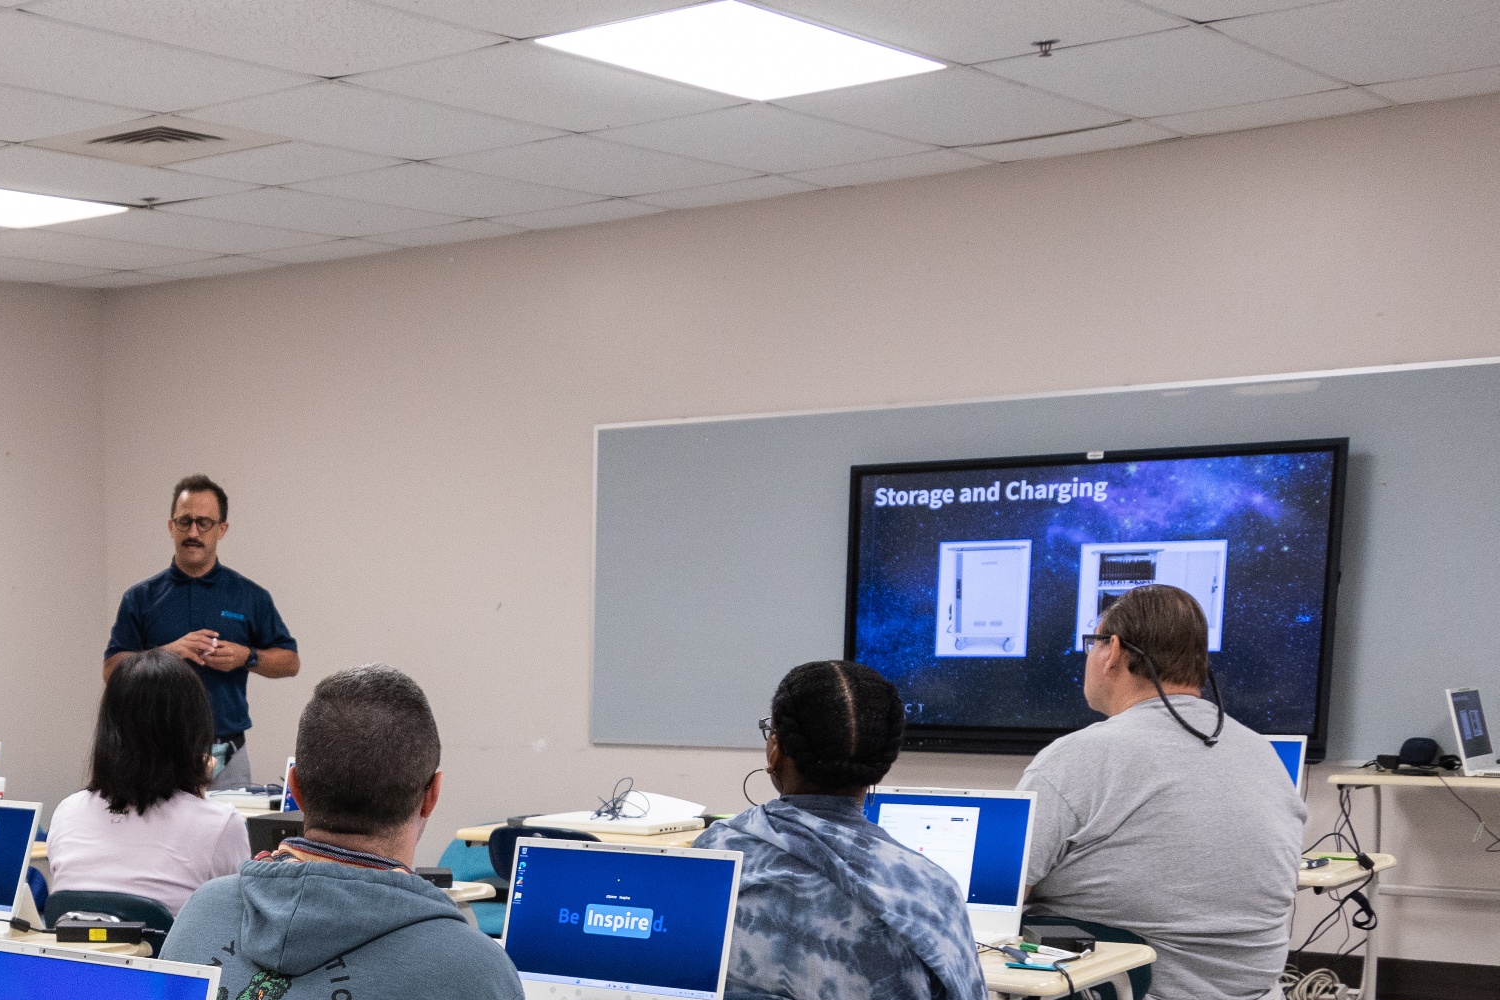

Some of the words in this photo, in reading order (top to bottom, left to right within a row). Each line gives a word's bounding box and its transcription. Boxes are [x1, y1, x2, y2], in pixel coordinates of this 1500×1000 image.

[875, 487, 955, 509] Storage
[959, 481, 1000, 503] and
[1006, 477, 1109, 503] Charging
[558, 908, 580, 925] Be
